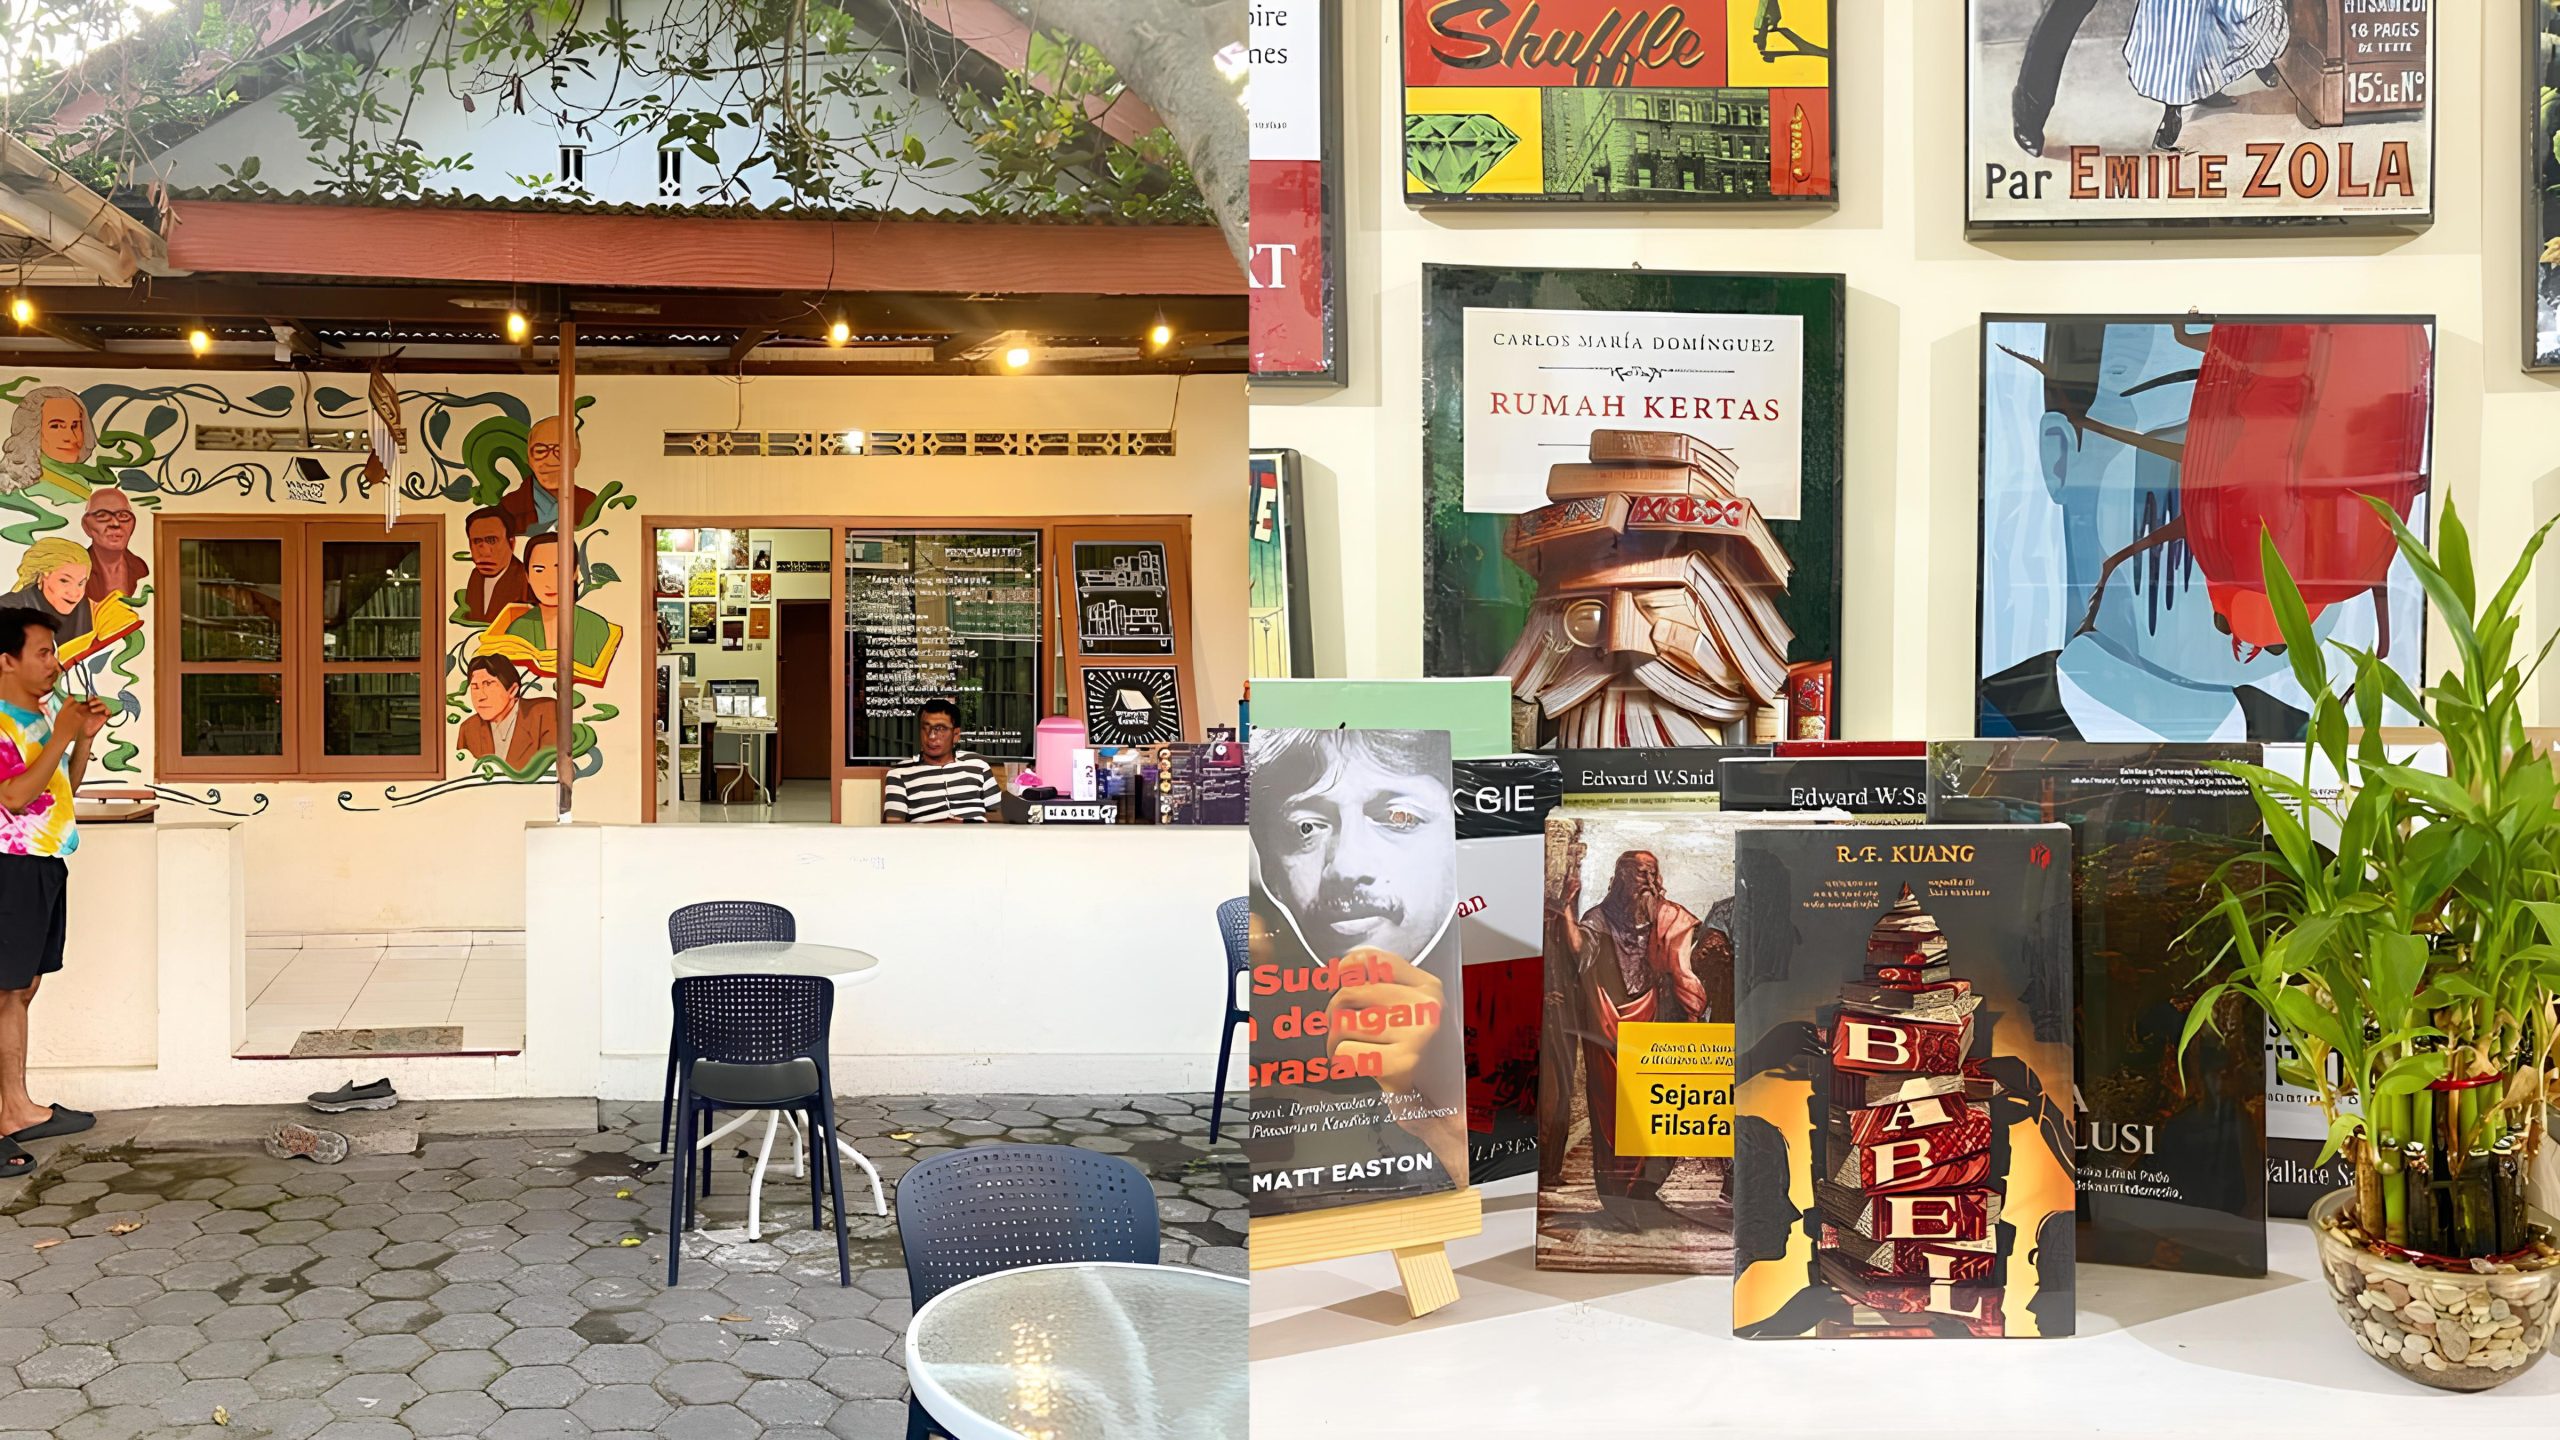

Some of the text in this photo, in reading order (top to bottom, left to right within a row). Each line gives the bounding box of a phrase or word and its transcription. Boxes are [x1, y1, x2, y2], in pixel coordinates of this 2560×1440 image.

[1427, 0, 1705, 87] Shuffle
[2373, 22, 2420, 38] PAGES
[1986, 141, 2415, 200] Par EMILE ZOLA
[1493, 331, 1776, 352] CARLOS MARÍA DOMÍNGUEZ
[1489, 391, 1780, 421] RUMAH KERTAS
[1789, 787, 1868, 806] Edward
[1889, 845, 1976, 863] KUANG
[1253, 955, 1394, 996] Sudah
[1273, 1001, 1442, 1040] dengan
[1651, 1113, 1735, 1136] Filsafa
[1252, 1151, 1434, 1193] MATT EASTON
